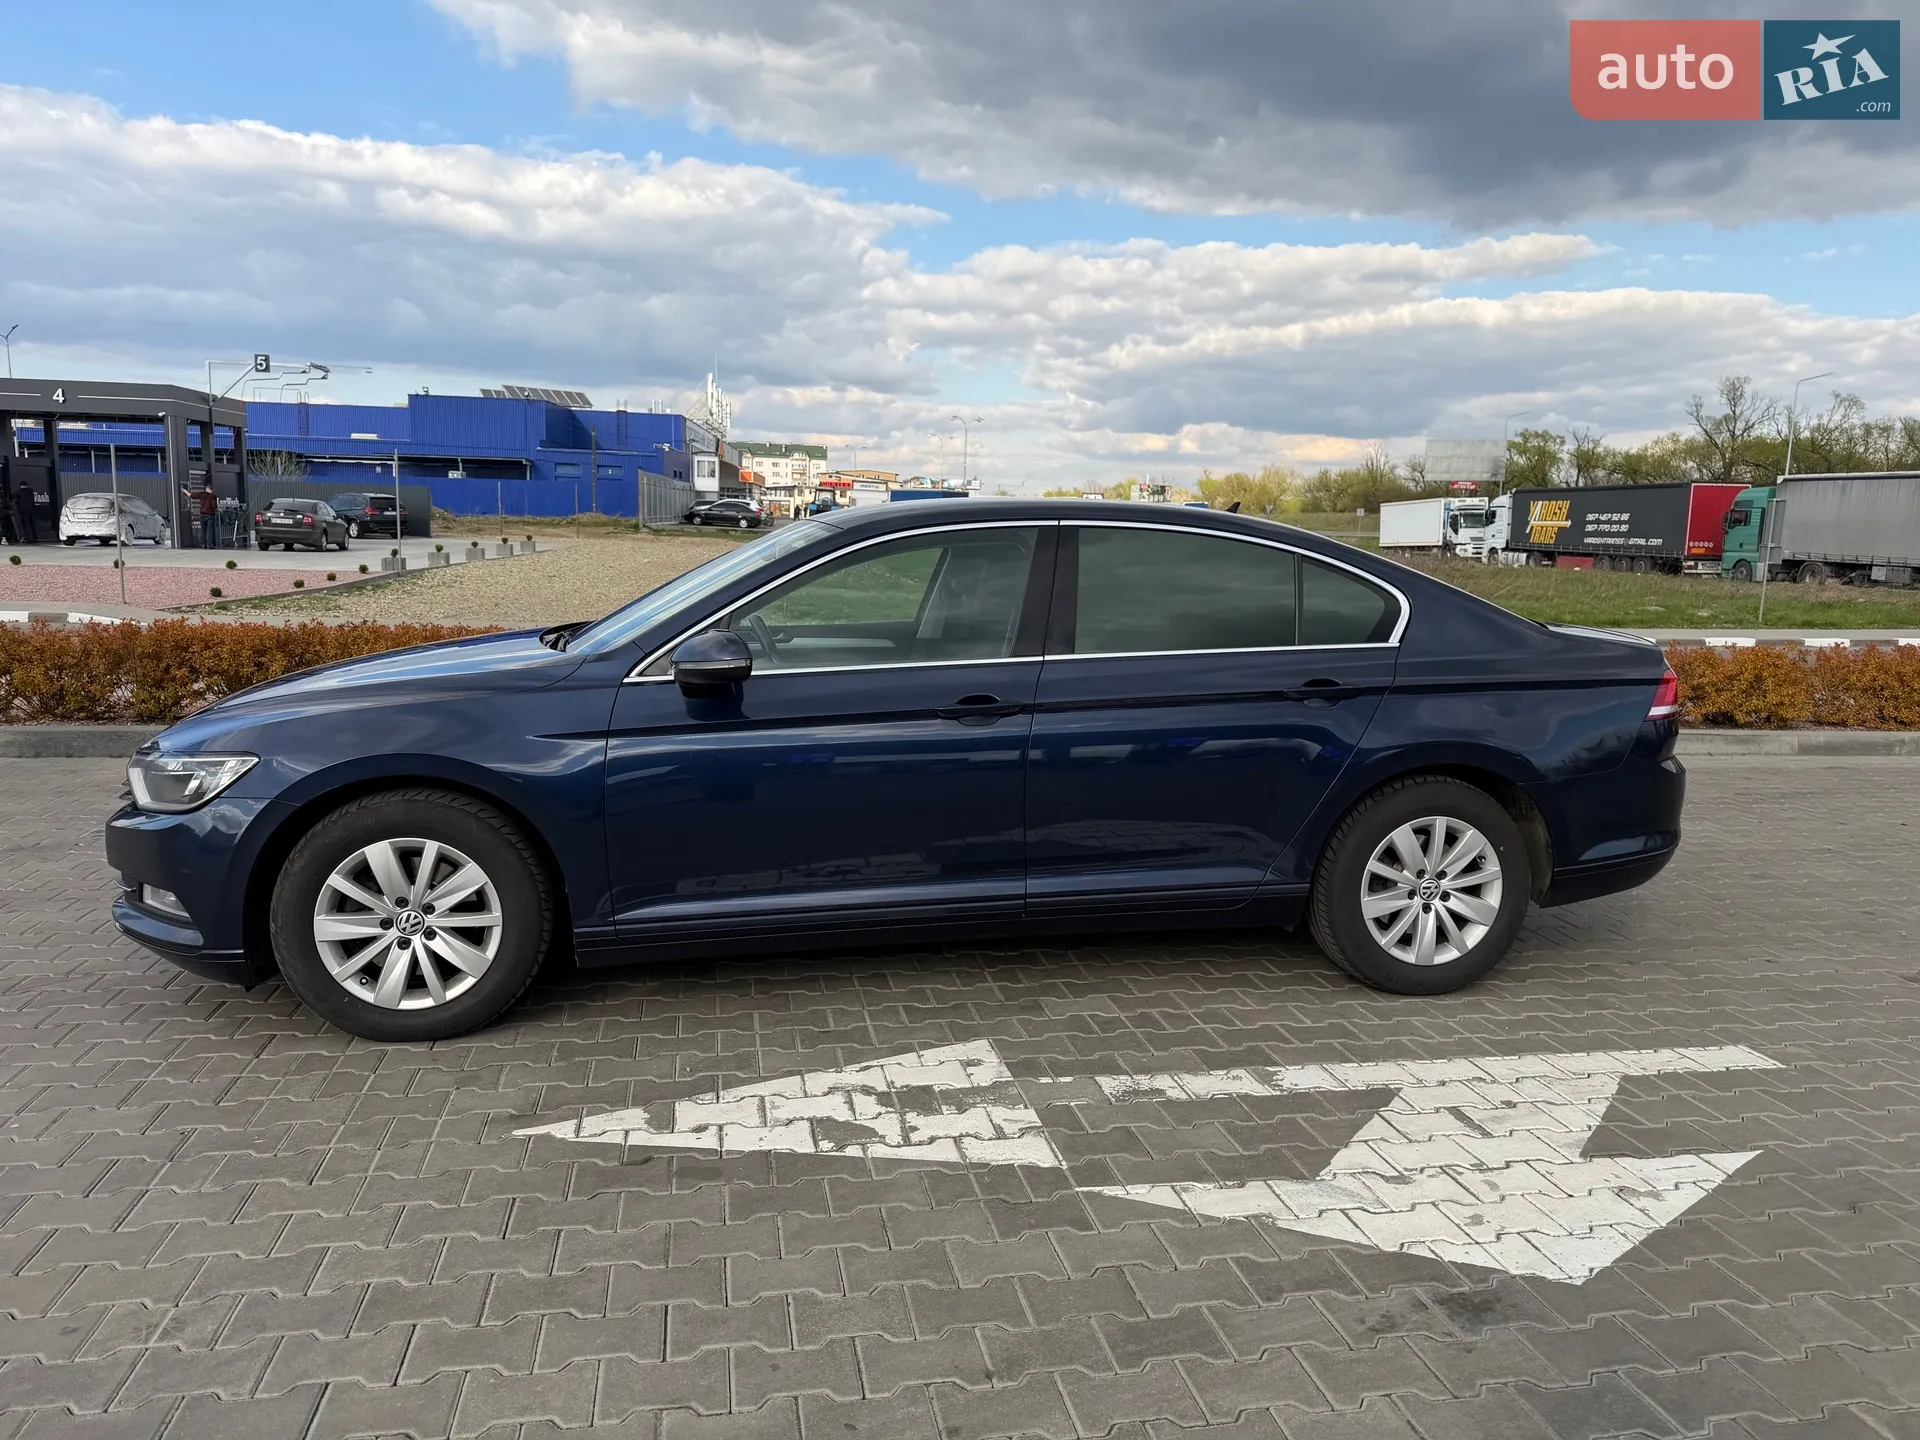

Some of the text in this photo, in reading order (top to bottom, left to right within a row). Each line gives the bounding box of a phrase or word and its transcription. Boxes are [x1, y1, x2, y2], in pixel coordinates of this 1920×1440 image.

[257, 356, 267, 370] 5
[52, 388, 65, 403] 4
[1529, 525, 1558, 544] TRANS
